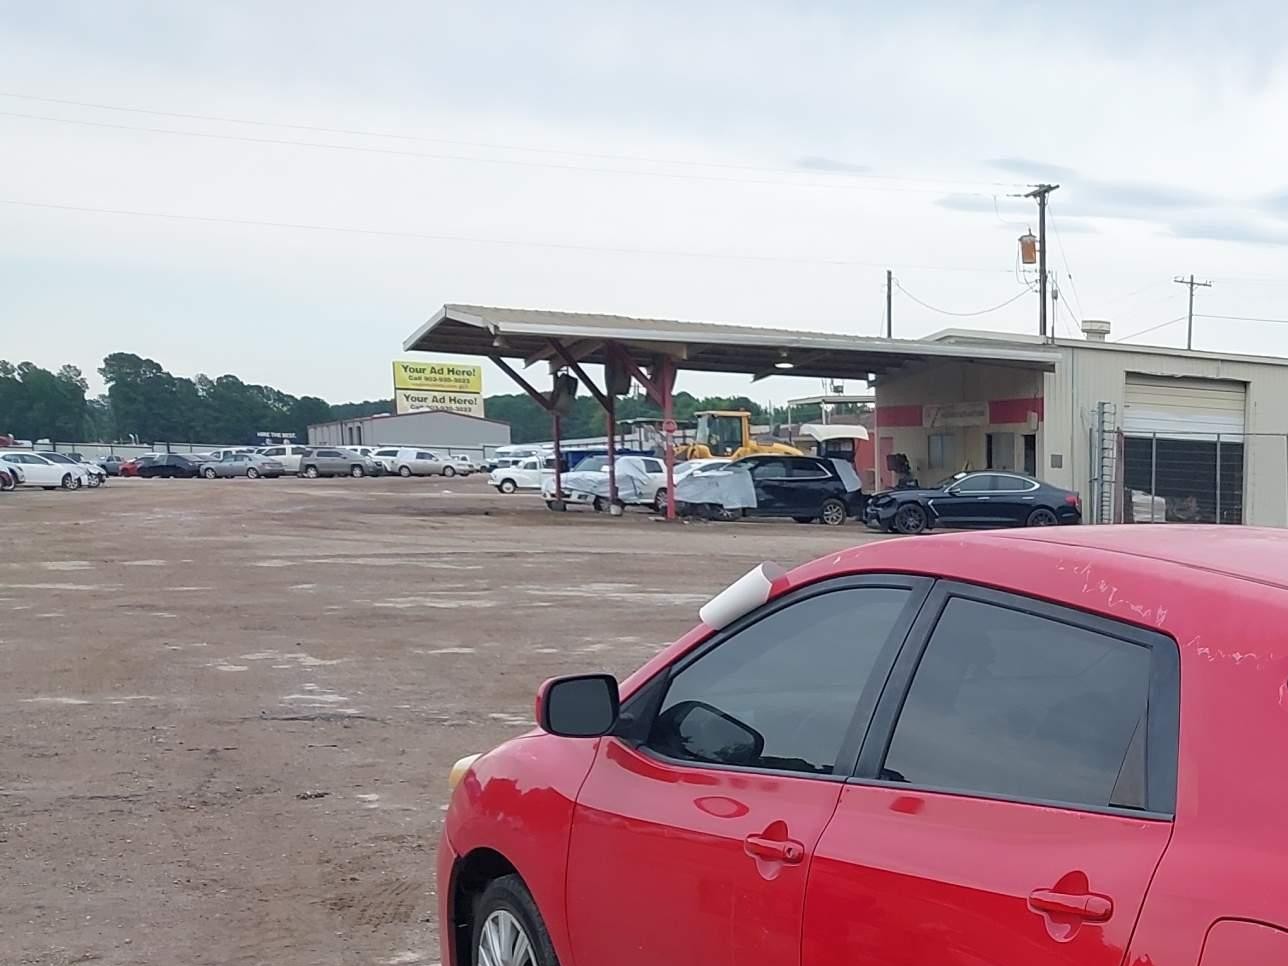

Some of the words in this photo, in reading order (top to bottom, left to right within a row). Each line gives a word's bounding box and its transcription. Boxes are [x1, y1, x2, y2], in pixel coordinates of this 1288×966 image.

[401, 364, 427, 374] Your
[430, 366, 444, 375] Ad
[447, 367, 476, 377] Here!
[403, 393, 428, 403] Your
[432, 395, 445, 404] Ad
[449, 396, 477, 406] Here!
